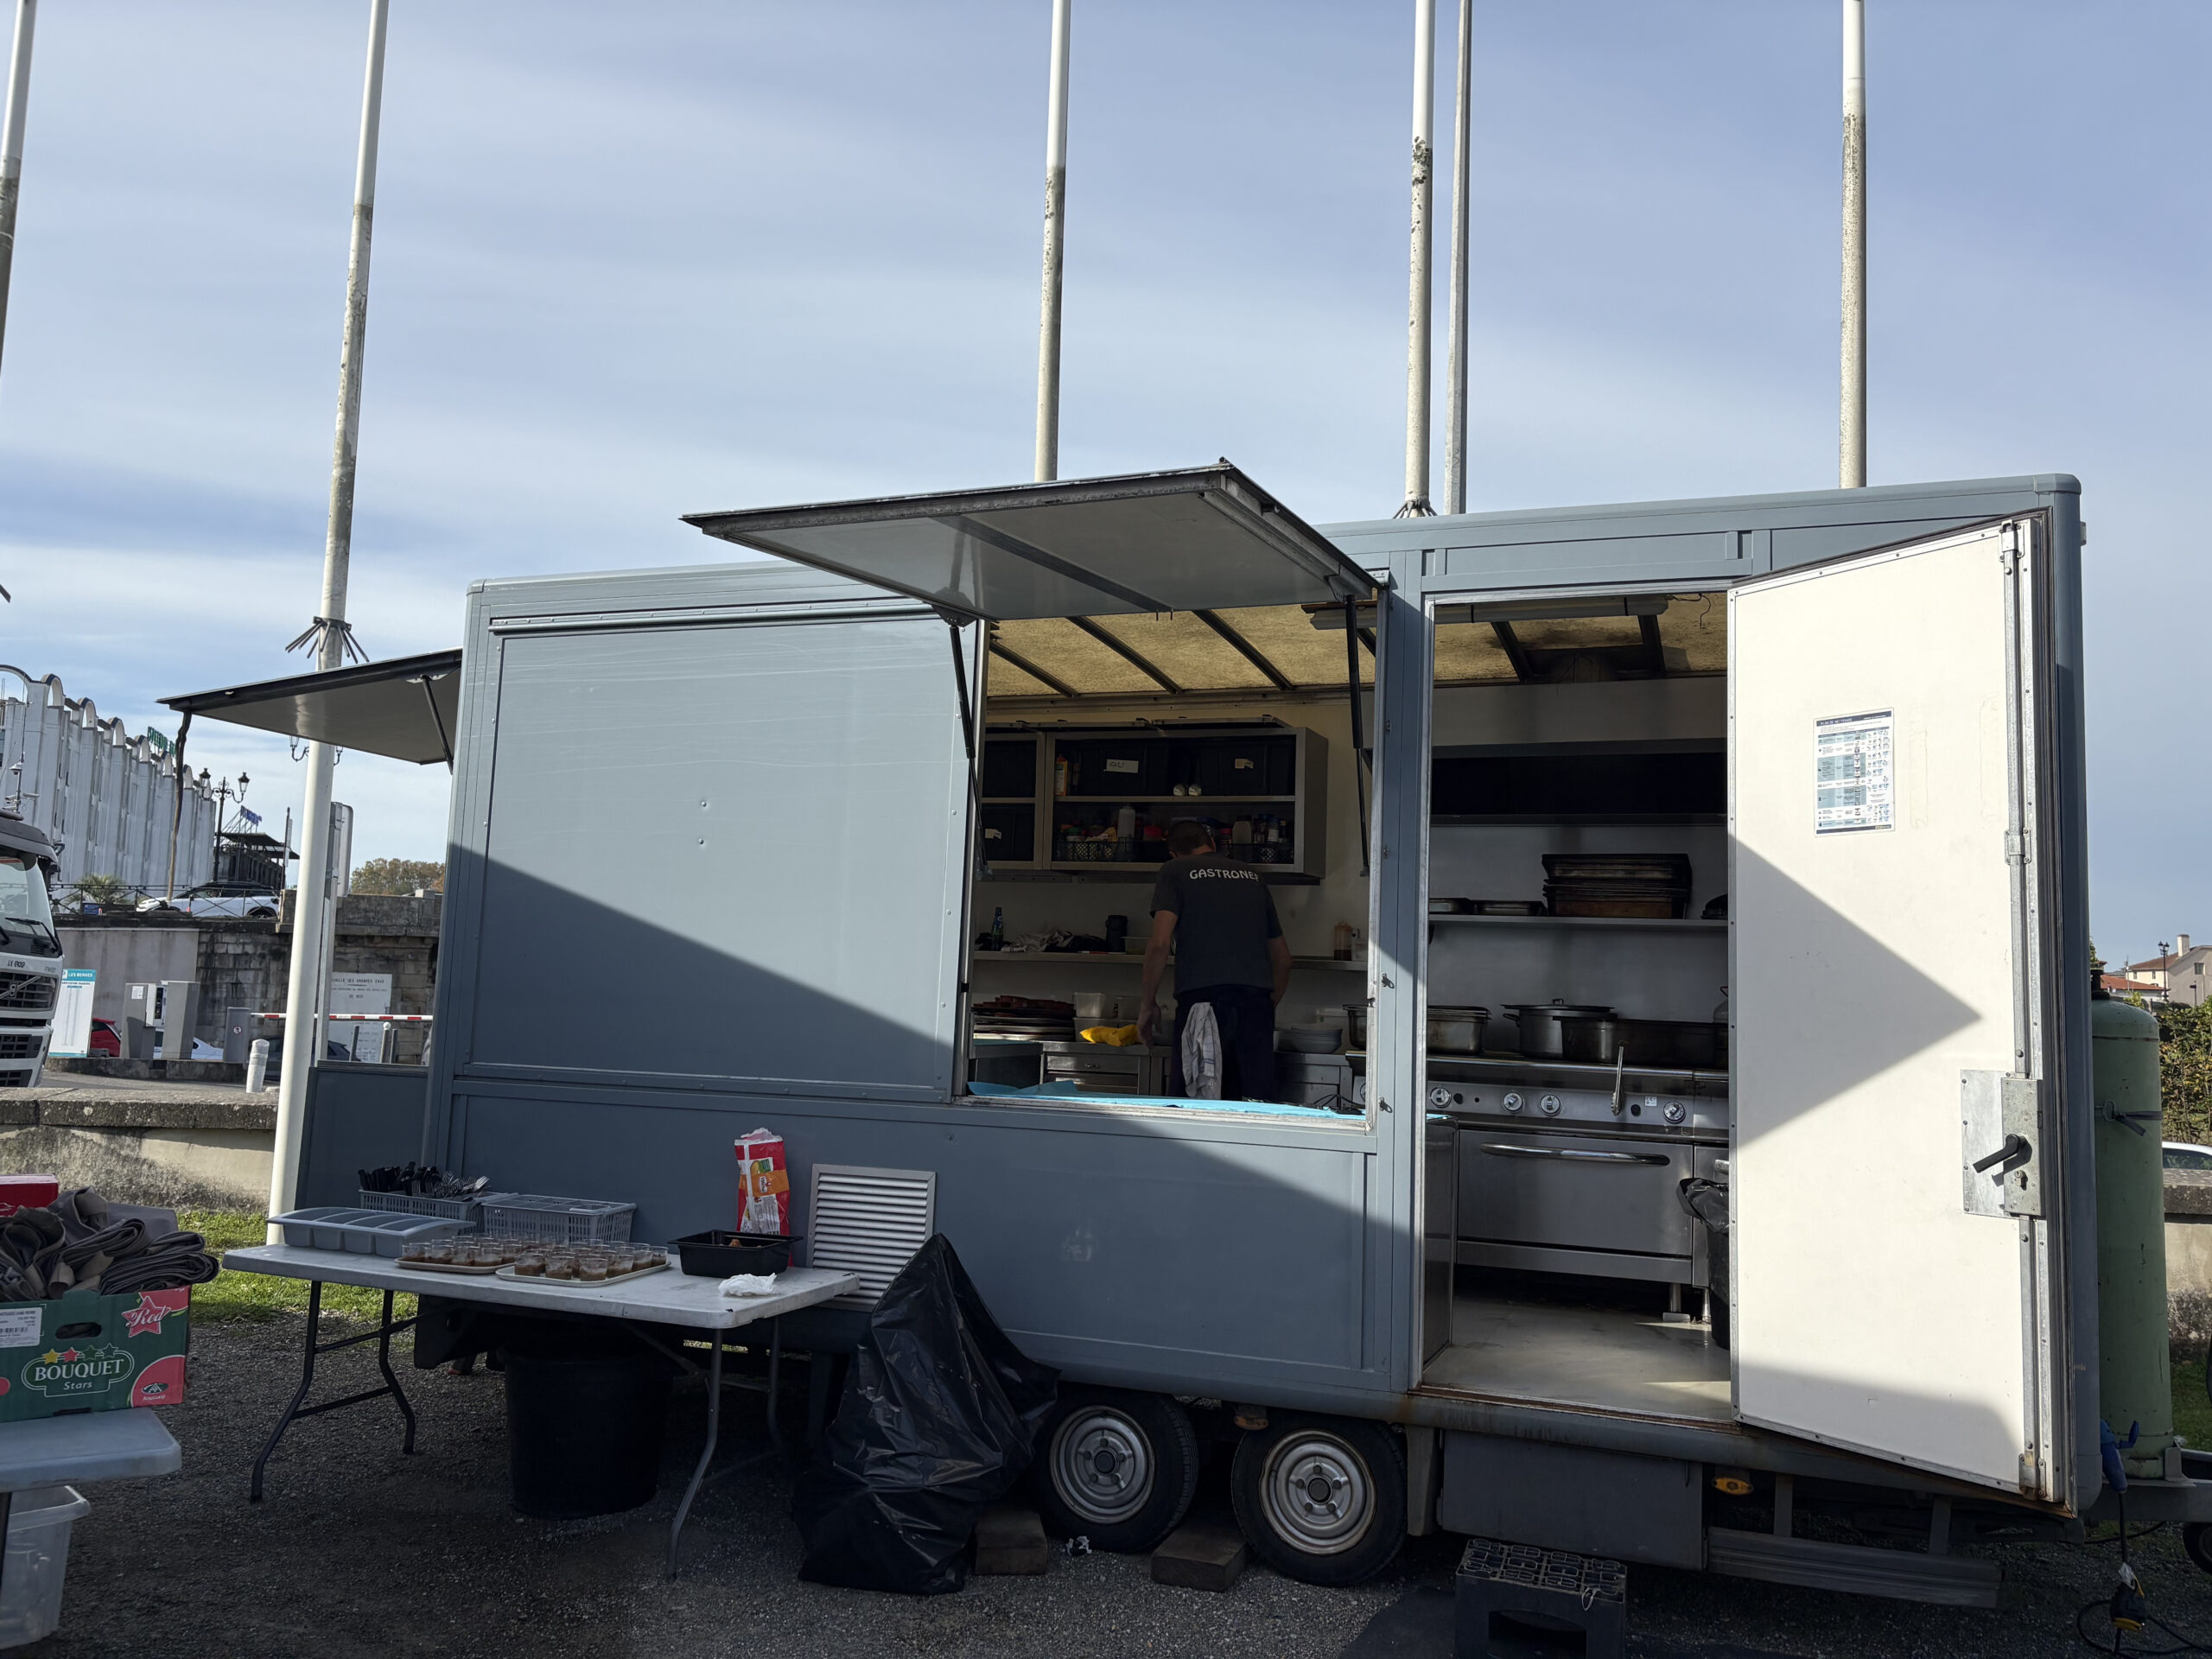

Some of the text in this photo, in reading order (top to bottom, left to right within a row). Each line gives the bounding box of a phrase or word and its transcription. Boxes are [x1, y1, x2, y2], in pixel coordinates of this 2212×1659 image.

[125, 1306, 167, 1328] Red
[35, 1359, 124, 1382] BOUQUET
[63, 1382, 92, 1390] Stars
